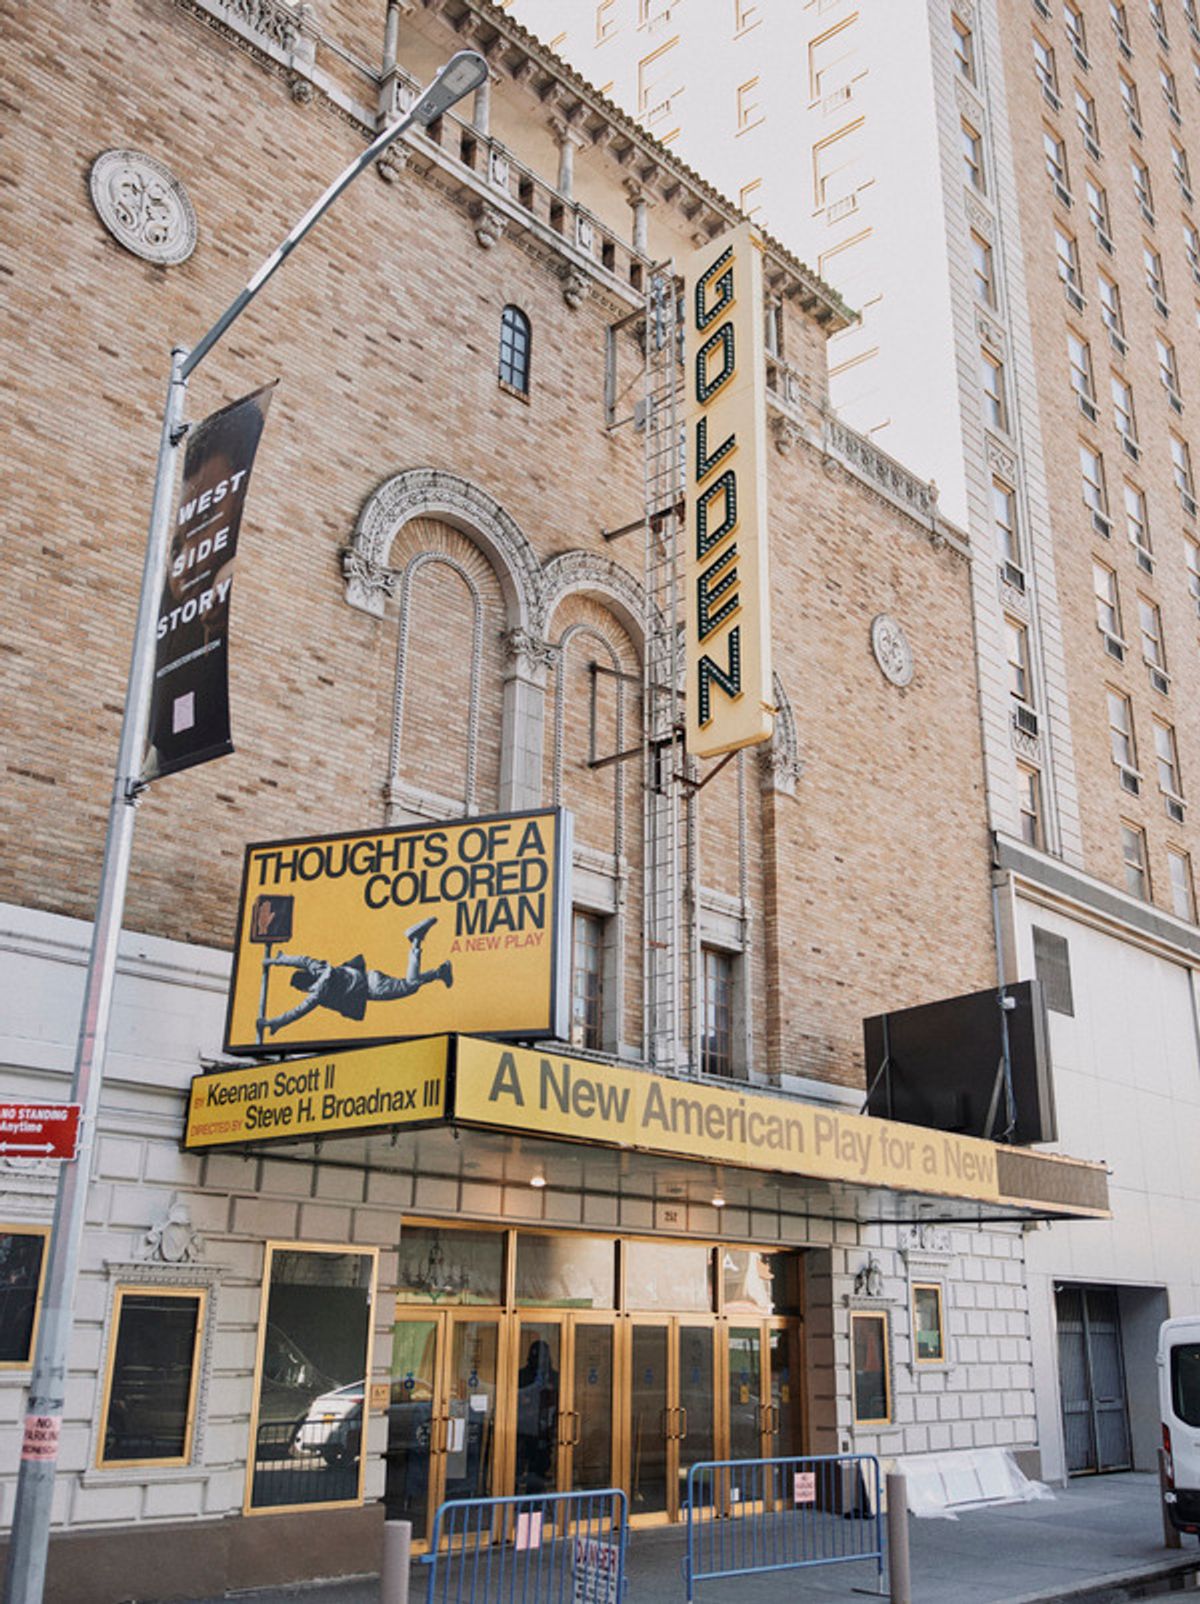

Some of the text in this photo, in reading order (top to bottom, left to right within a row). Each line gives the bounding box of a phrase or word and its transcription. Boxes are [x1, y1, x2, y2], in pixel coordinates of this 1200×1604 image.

[178, 469, 247, 526] WEST
[696, 245, 740, 729] GOLDEN
[171, 526, 229, 577] SIDE
[156, 577, 232, 639] STORY
[254, 821, 545, 885] THOUGHTS OF A
[364, 858, 548, 909] COLORED
[455, 893, 545, 936] MAN
[450, 932, 544, 953] A NEW PLAY
[191, 1079, 440, 1136] DIRECTED BY Steve H. Broadnax III
[194, 1063, 335, 1109] BY Keenan Scott II
[1, 1108, 68, 1121] NO STANDING
[488, 1051, 995, 1184] A New American Play for a New
[36, 1418, 52, 1429] NO
